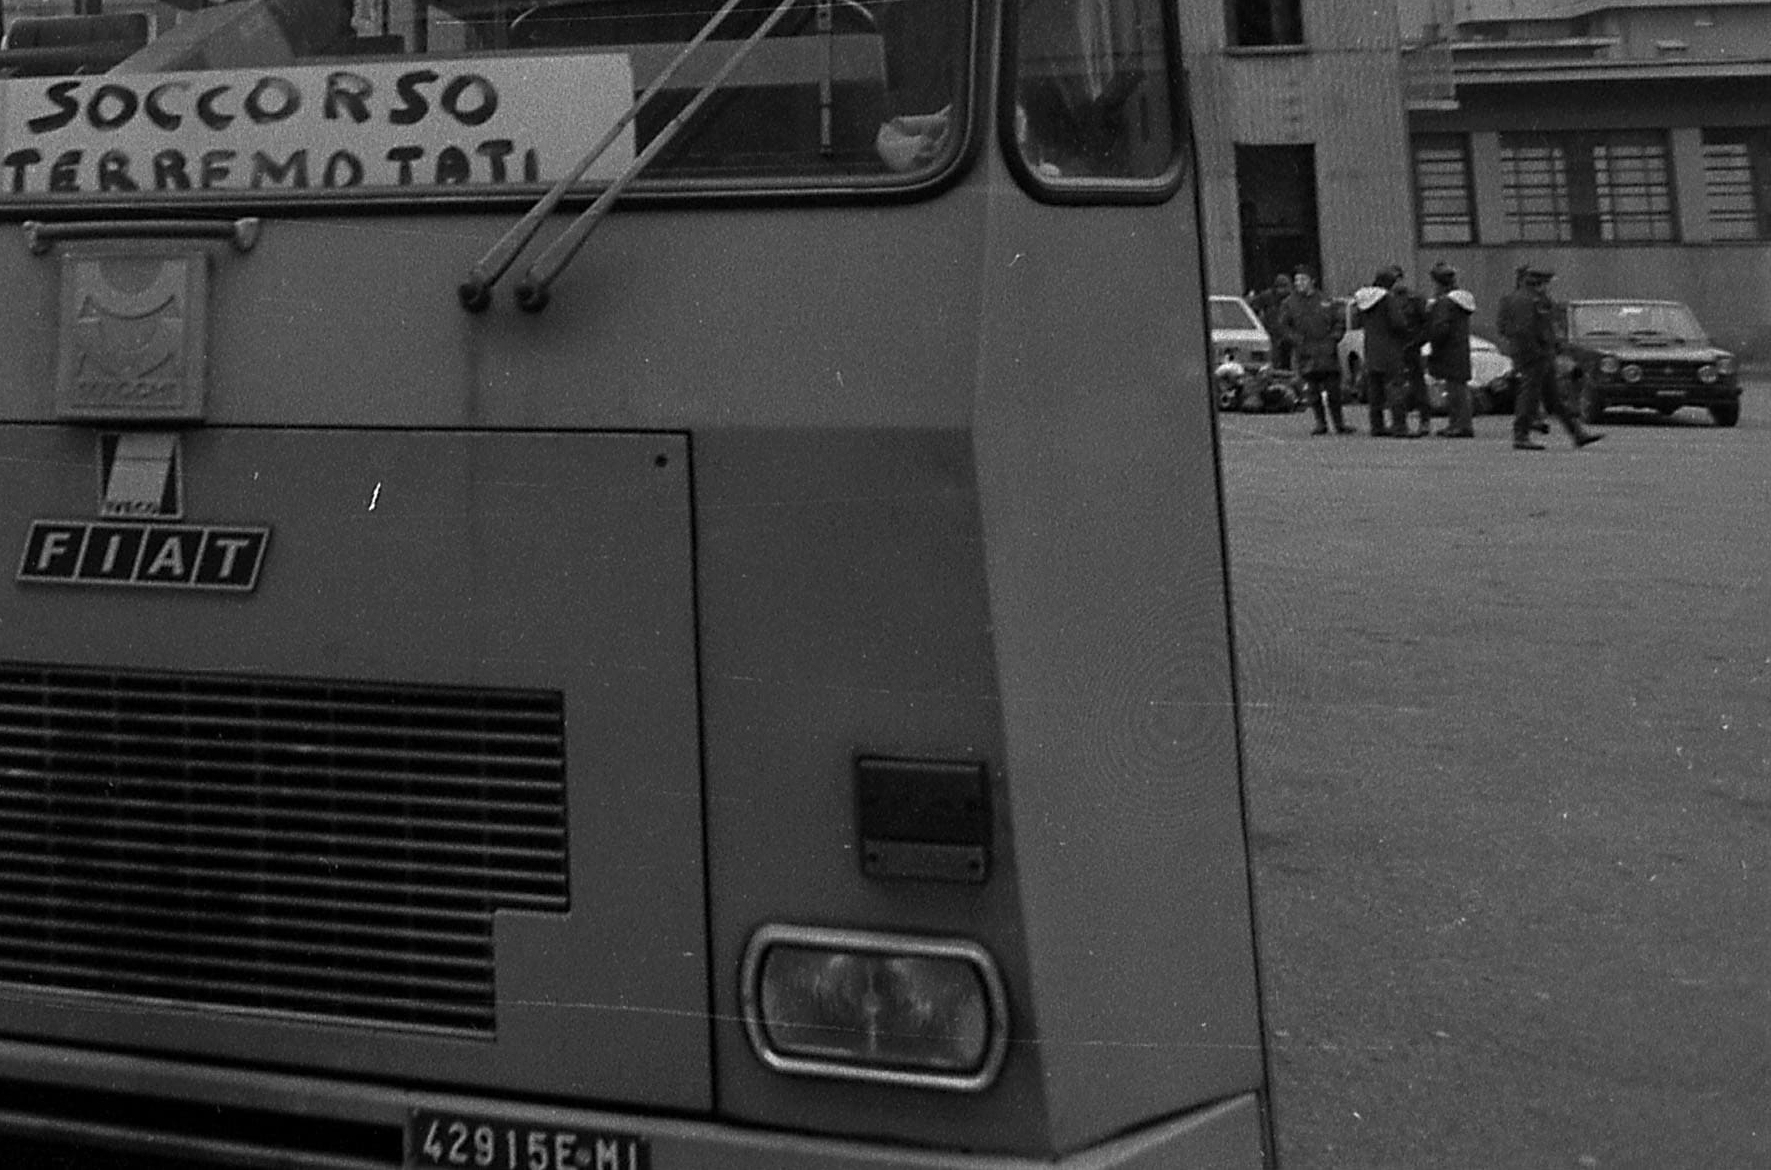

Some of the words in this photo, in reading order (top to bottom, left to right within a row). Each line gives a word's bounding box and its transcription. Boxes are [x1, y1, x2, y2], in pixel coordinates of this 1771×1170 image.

[27, 70, 500, 134] SOCCORSO
[2, 138, 541, 194] TERREMOTATI
[36, 530, 251, 579] FIAT
